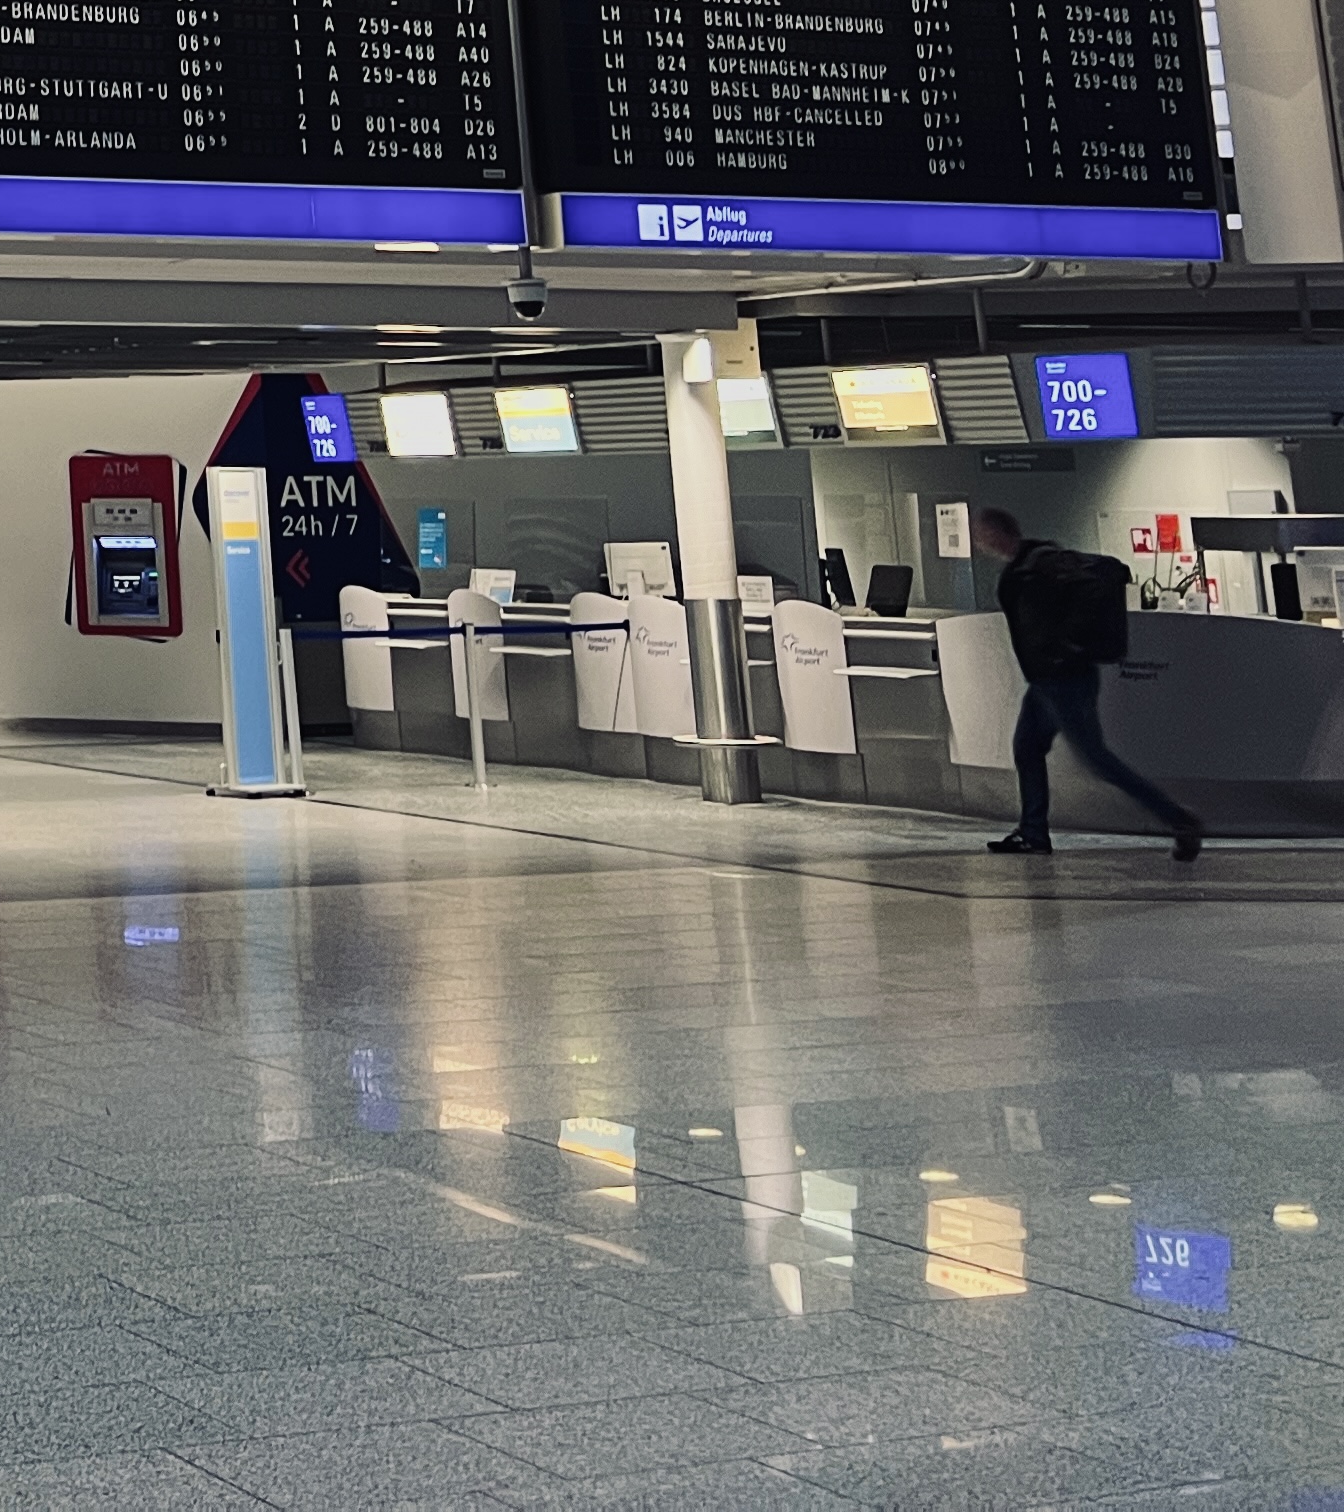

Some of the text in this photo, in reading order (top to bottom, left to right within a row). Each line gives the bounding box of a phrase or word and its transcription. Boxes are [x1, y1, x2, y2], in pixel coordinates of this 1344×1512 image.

[706, 205, 747, 226] Abflug
[707, 225, 773, 245] Departures
[1046, 379, 1107, 403] 700-
[1051, 407, 1098, 431] 726
[312, 438, 337, 457] 726
[103, 462, 140, 475] ATM
[280, 475, 357, 508] ATM
[281, 514, 323, 537] 24h
